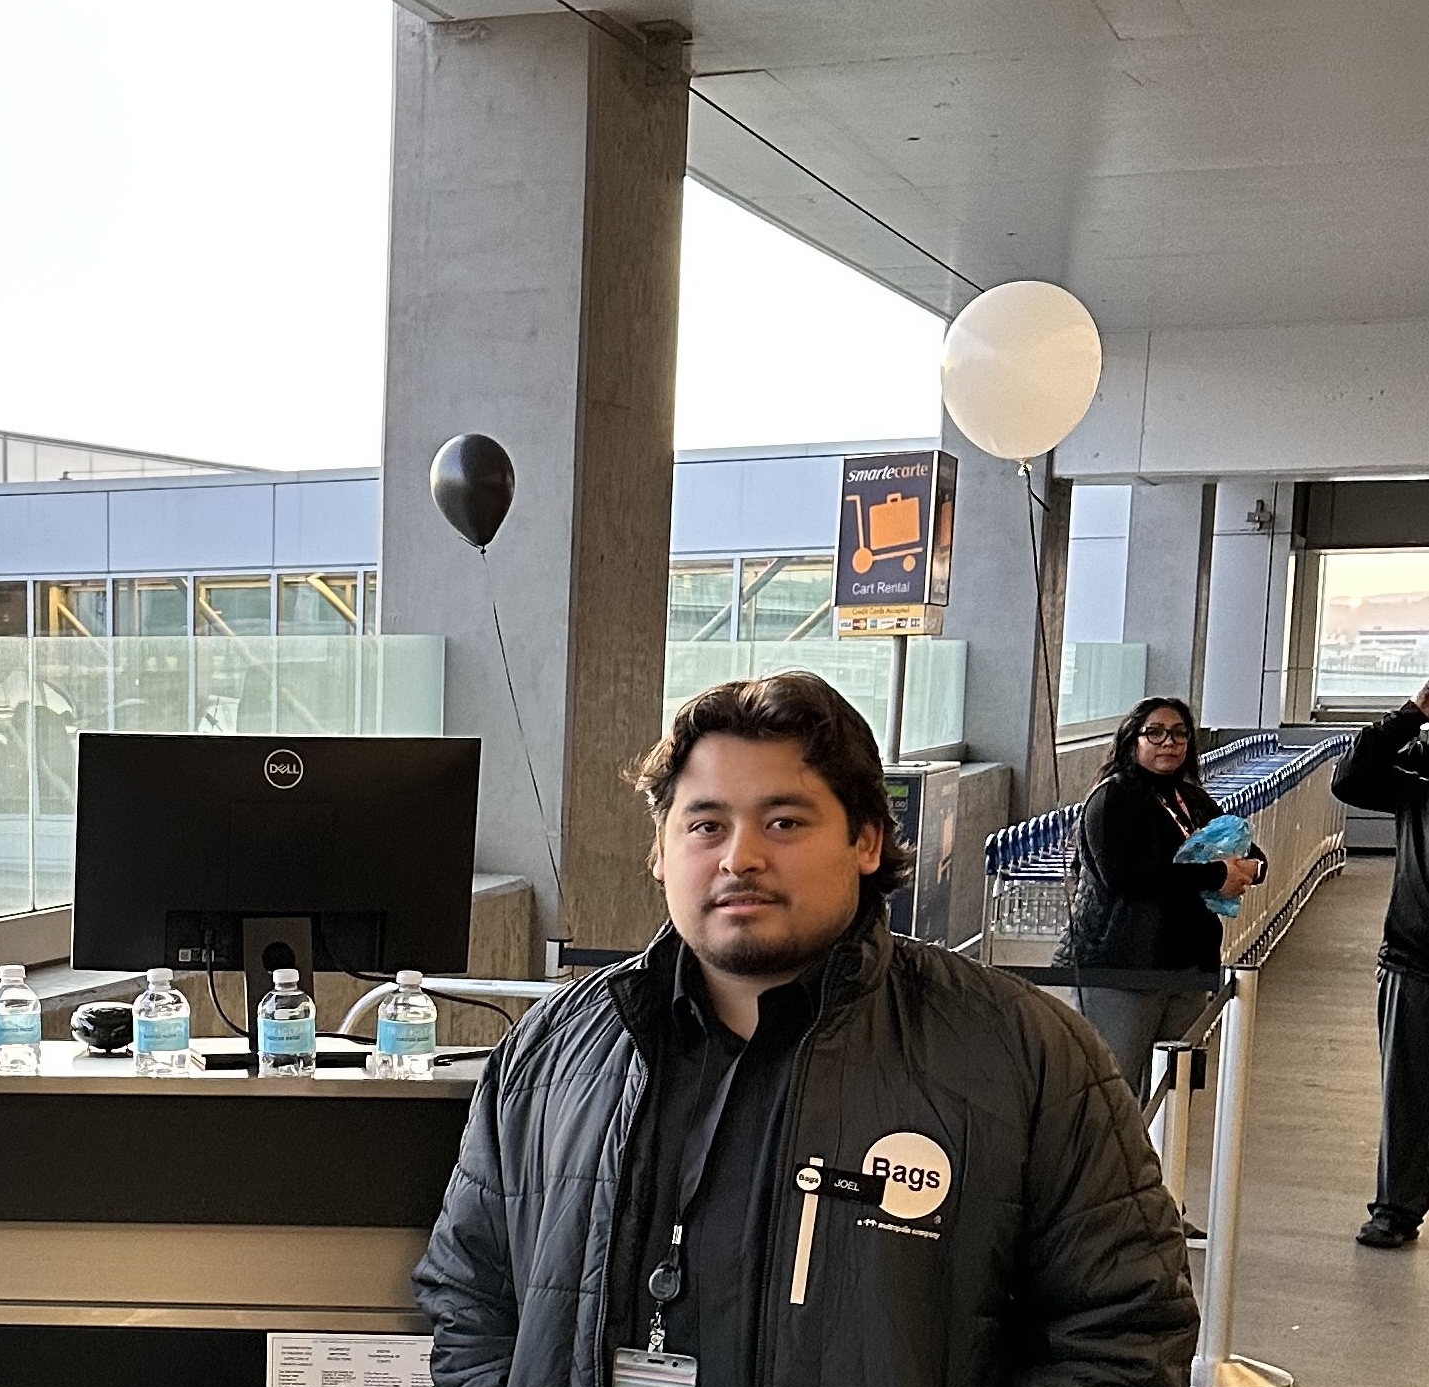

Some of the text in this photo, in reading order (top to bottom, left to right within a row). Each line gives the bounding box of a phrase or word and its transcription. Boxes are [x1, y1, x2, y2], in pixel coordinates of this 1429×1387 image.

[847, 463, 928, 482] smartecarte
[852, 581, 910, 595] Cart Rental
[270, 764, 299, 774] DELL
[799, 1173, 819, 1183] Bags
[872, 1157, 941, 1192] Bags
[834, 1179, 860, 1191] JOEL
